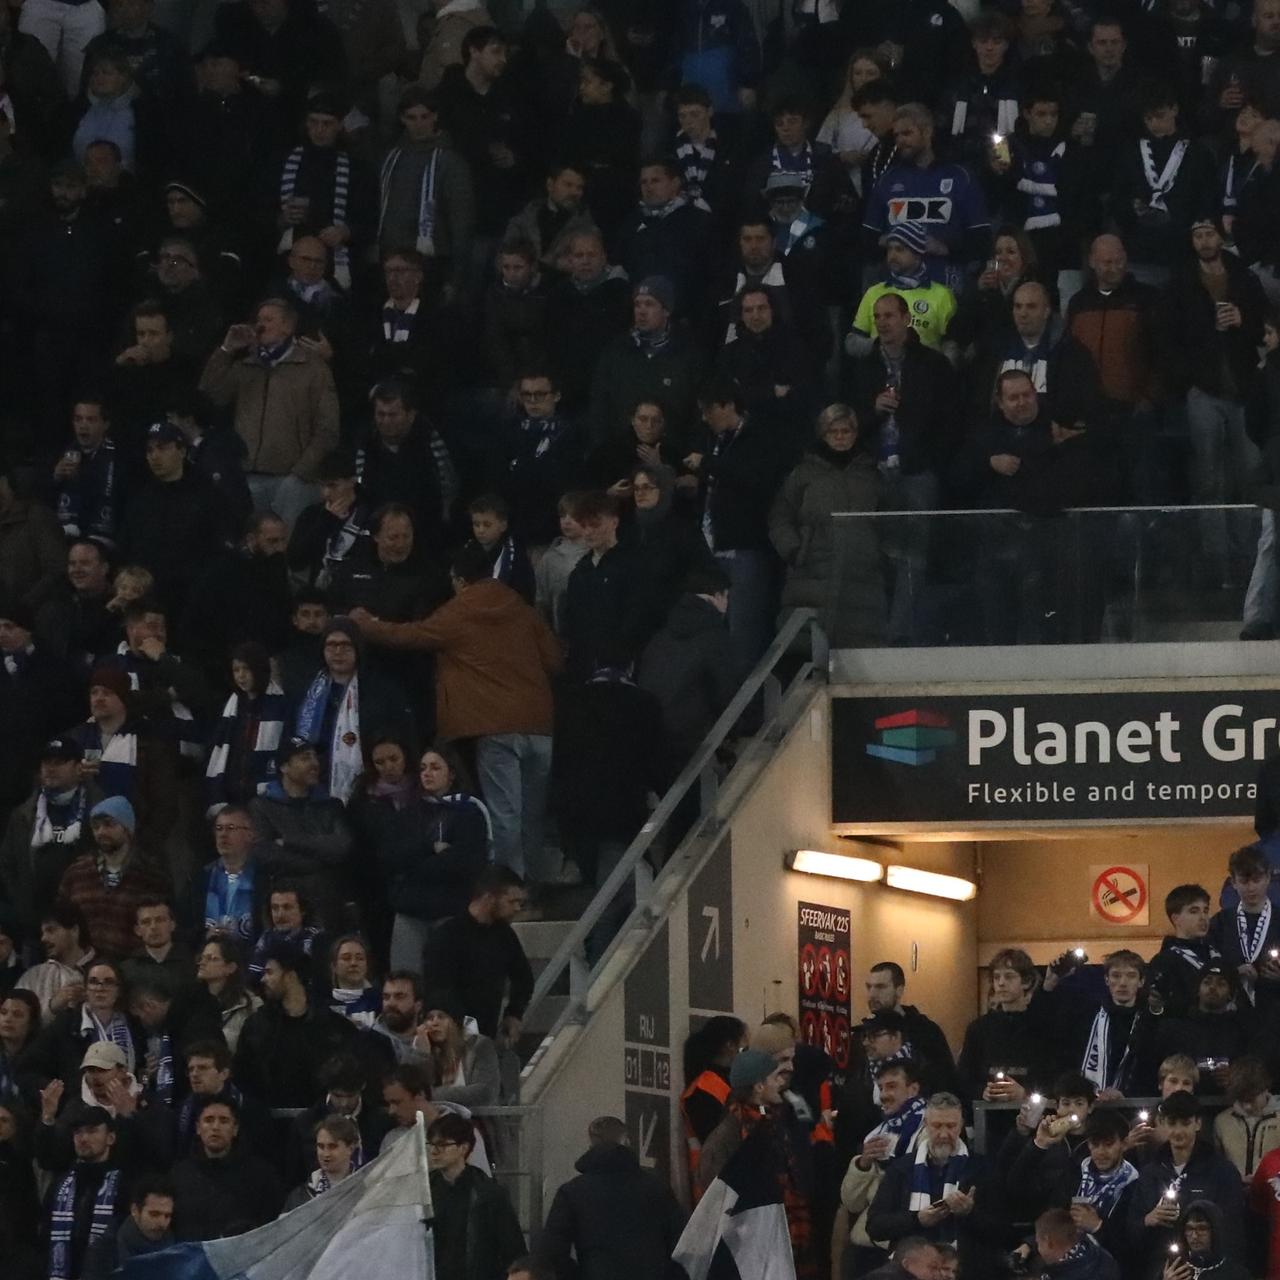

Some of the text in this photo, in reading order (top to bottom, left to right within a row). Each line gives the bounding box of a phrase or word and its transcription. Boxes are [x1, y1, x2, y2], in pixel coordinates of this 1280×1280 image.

[911, 316, 930, 327] ise
[968, 706, 1181, 766] Planet
[968, 781, 1256, 804] Flexible and tempora
[800, 908, 849, 933] SFEERVAK 225
[640, 1014, 655, 1040] RIJ
[626, 1056, 638, 1079] 01
[656, 1060, 669, 1086] 12
